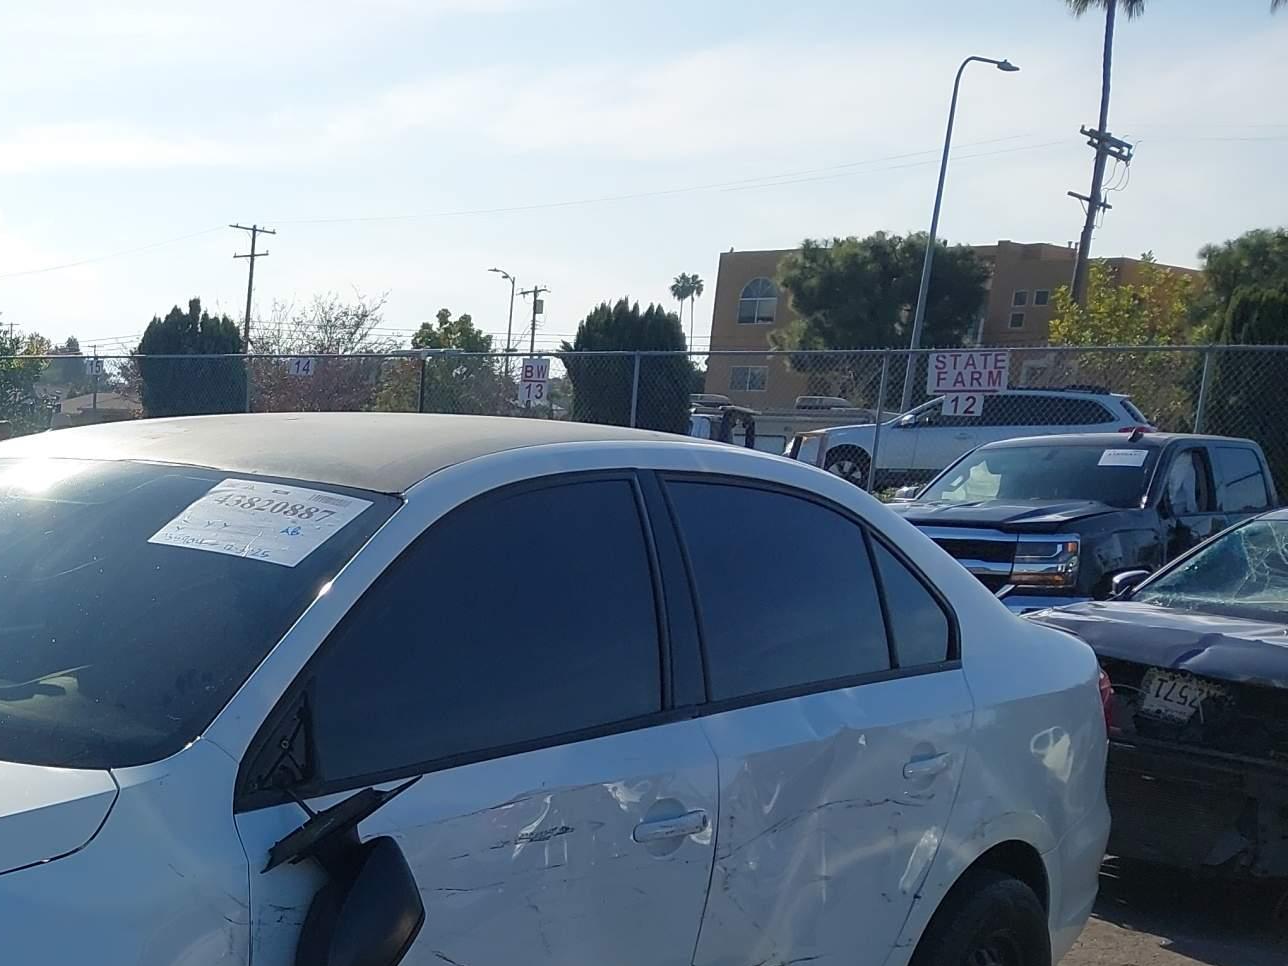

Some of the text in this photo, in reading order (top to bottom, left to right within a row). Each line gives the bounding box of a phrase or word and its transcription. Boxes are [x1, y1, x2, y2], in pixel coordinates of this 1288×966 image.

[89, 360, 101, 373] 15
[295, 360, 311, 375] 14
[934, 353, 1007, 370] STATE
[524, 364, 548, 378] BW
[935, 371, 1002, 388] FARM
[525, 383, 545, 400] 13
[951, 395, 977, 415] 12
[214, 494, 337, 522] 43820887
